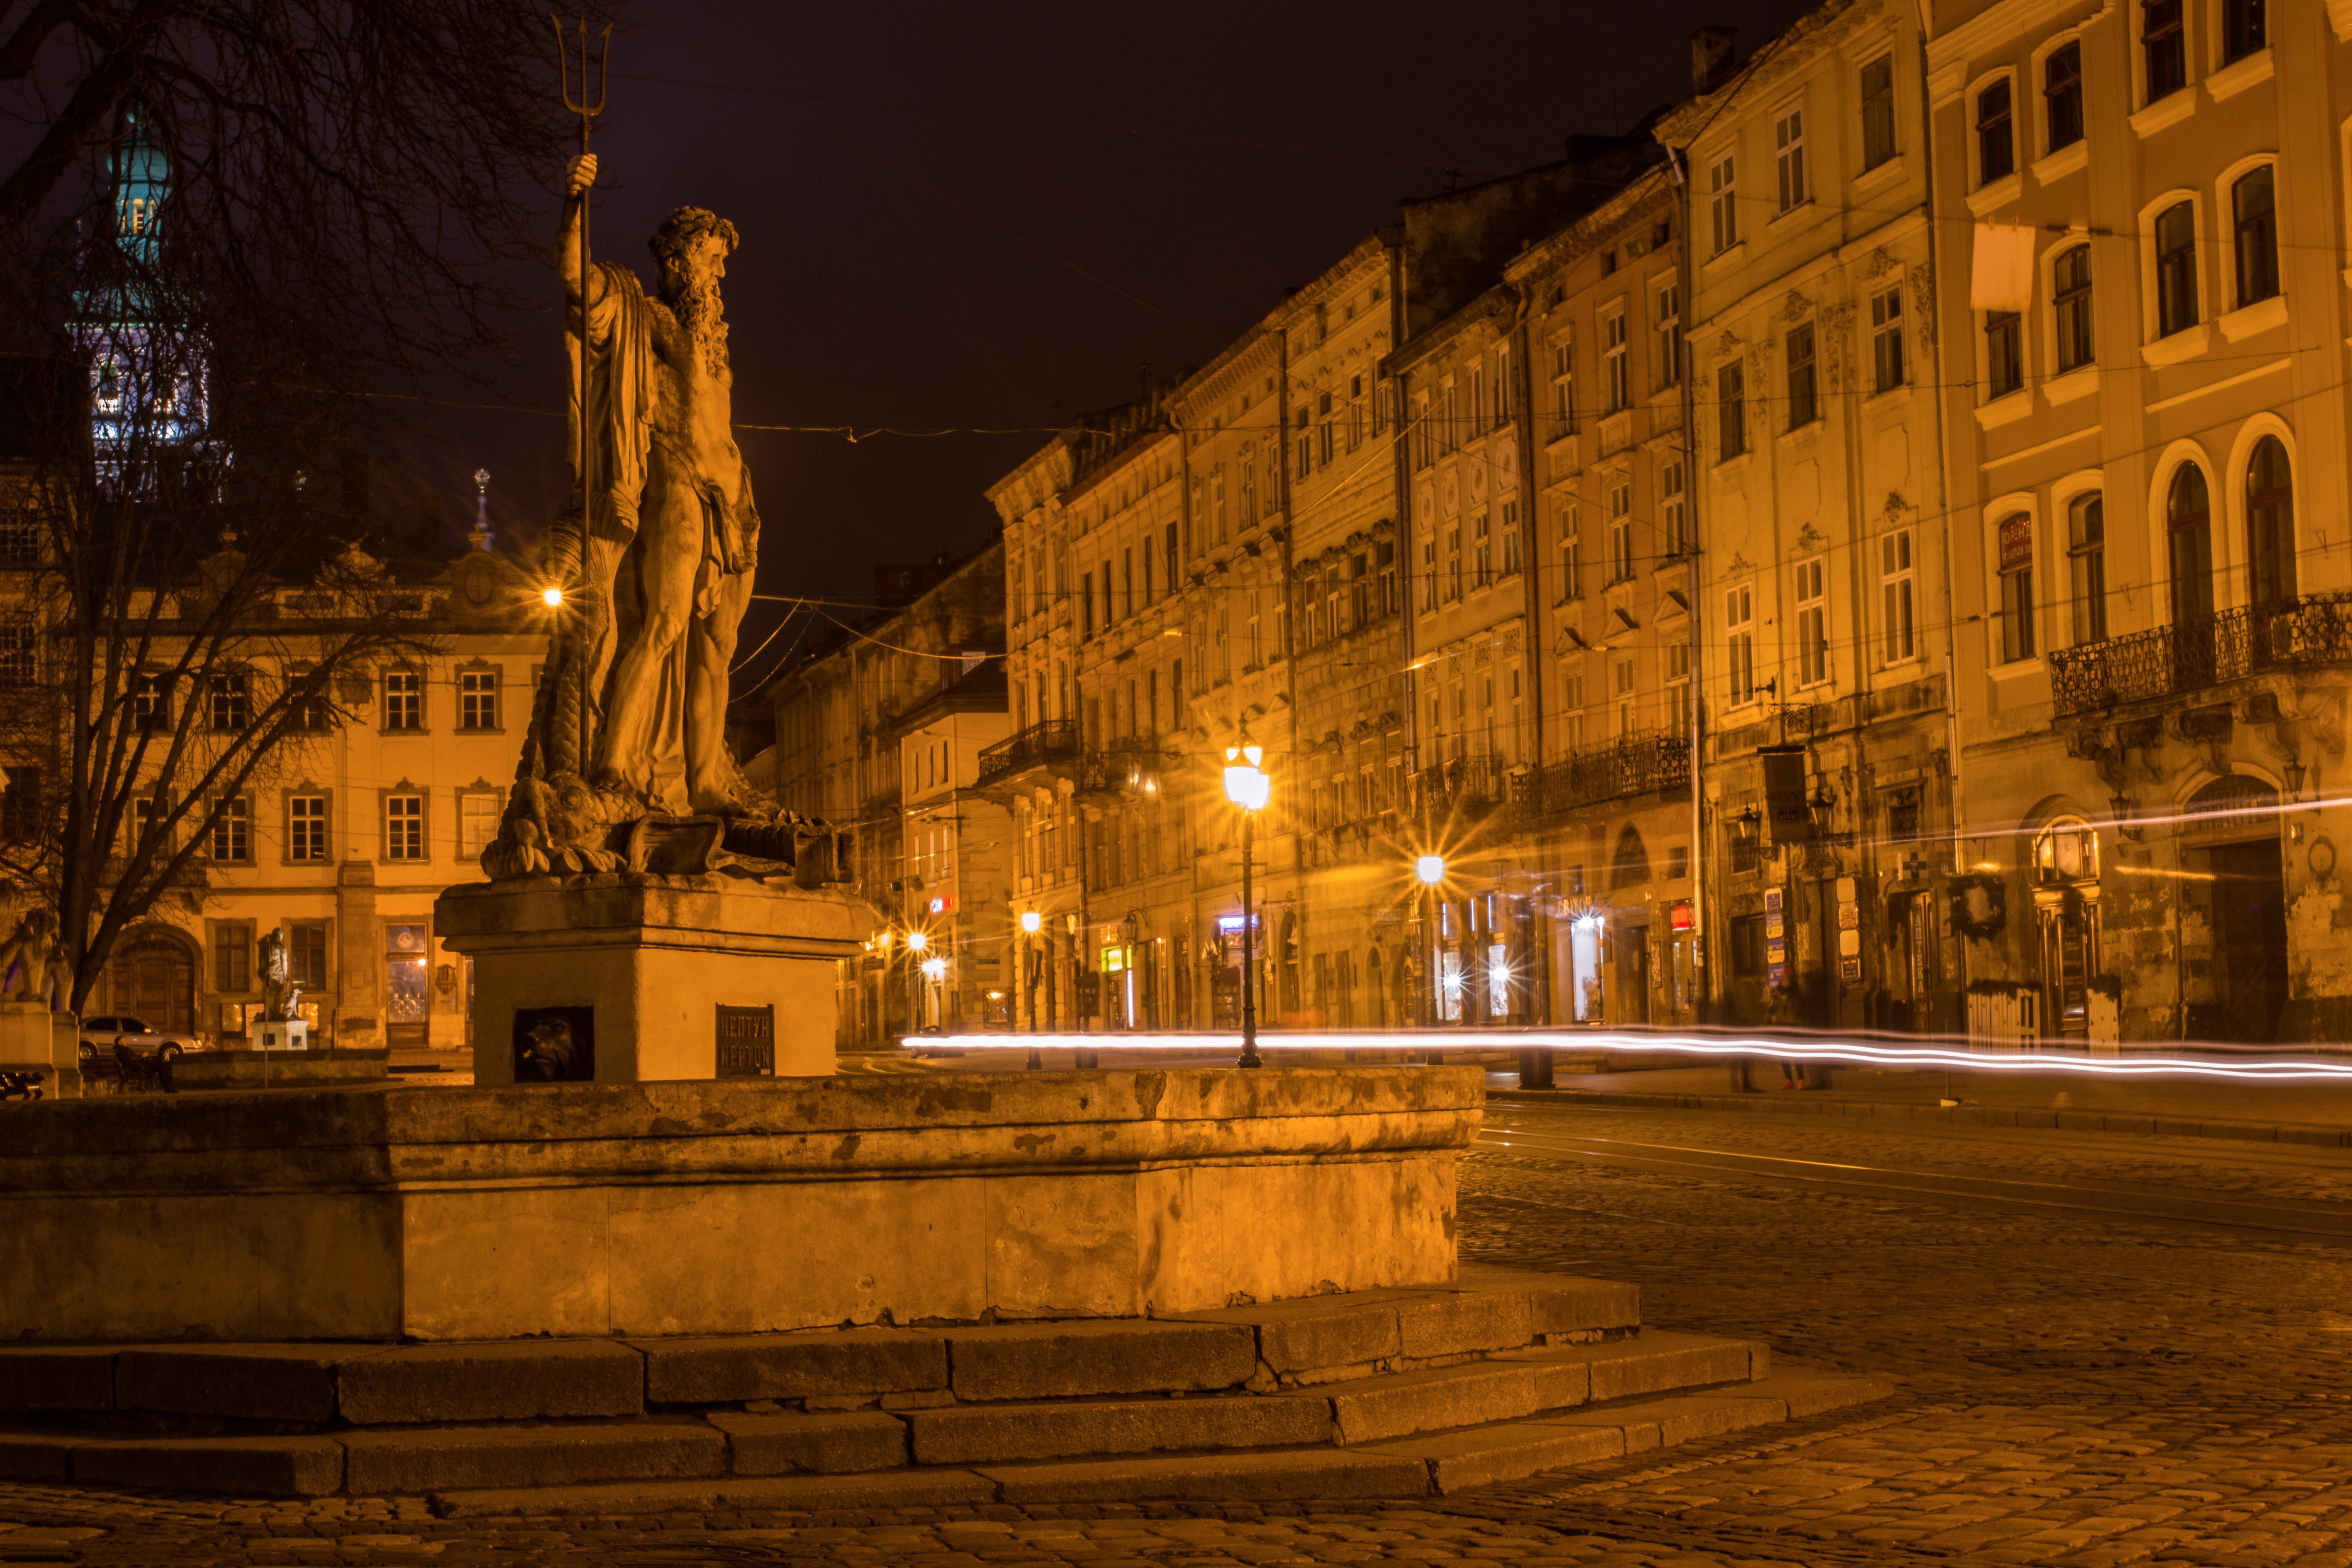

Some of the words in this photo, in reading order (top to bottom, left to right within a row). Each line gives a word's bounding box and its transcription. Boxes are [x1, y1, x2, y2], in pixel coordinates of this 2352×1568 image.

[1915, 914, 1924, 993] АПТЕКА
[719, 1016, 769, 1037] НЕПТУН
[720, 1046, 770, 1067] NEPTUN
